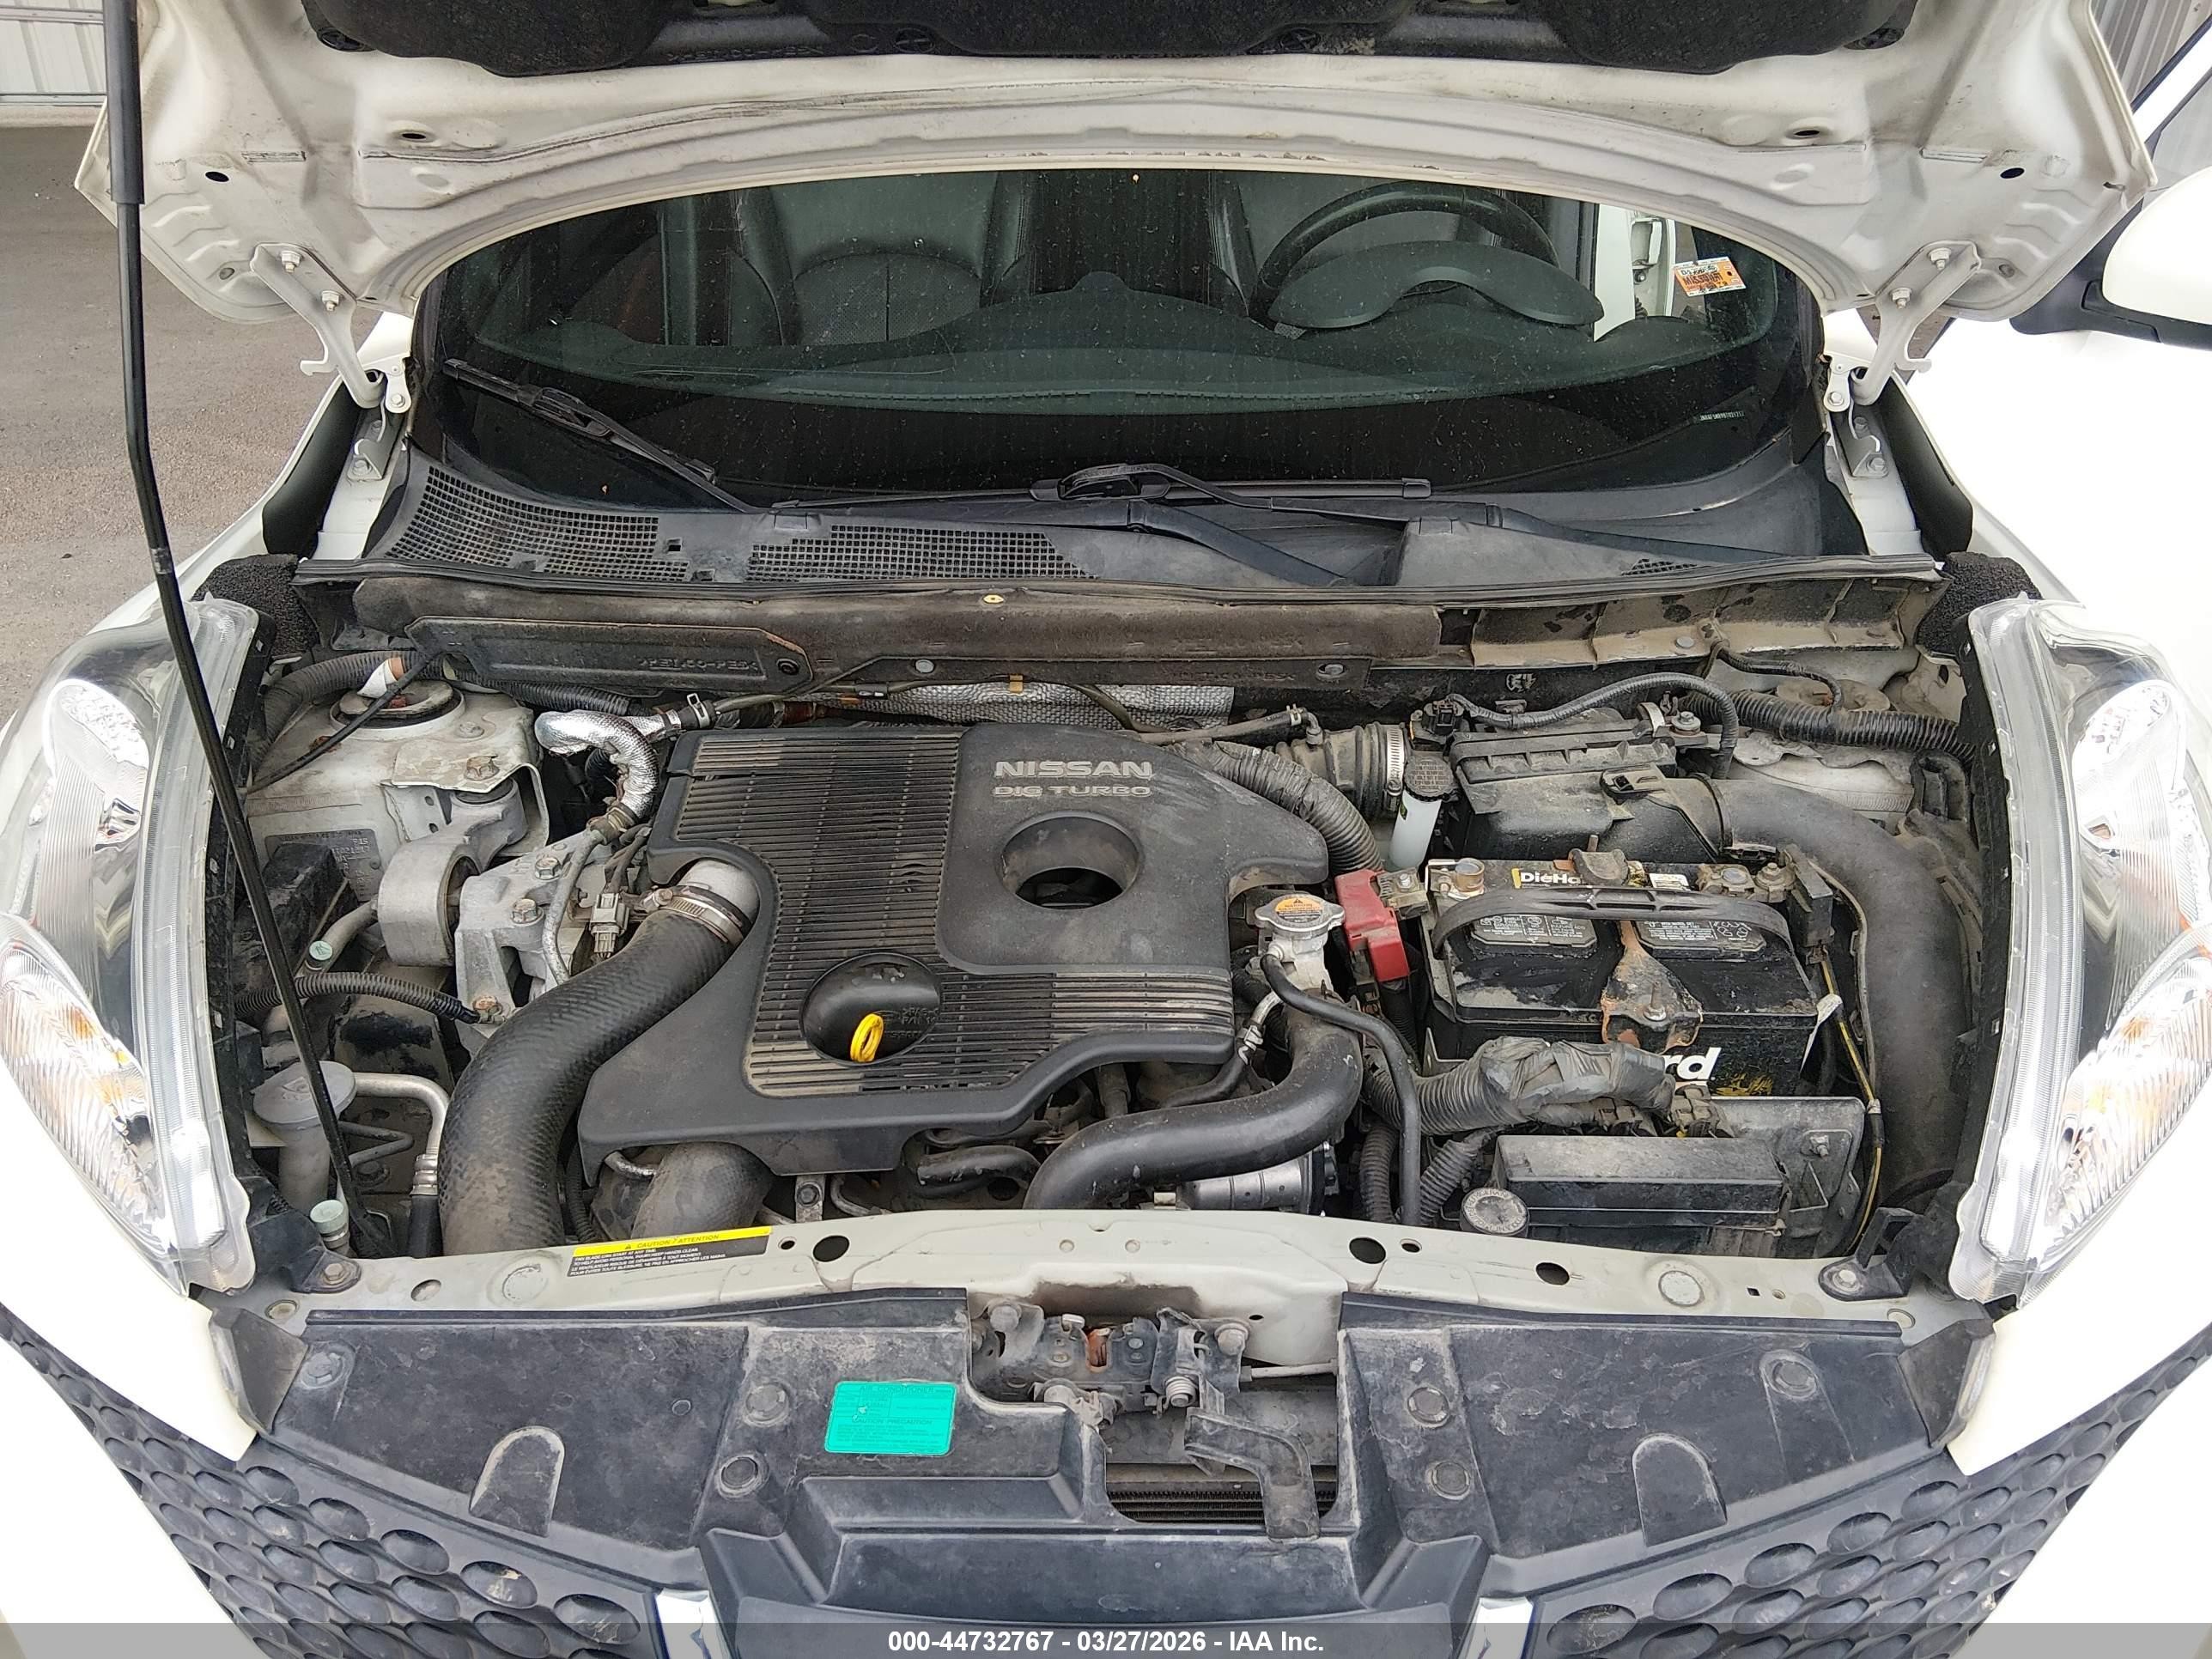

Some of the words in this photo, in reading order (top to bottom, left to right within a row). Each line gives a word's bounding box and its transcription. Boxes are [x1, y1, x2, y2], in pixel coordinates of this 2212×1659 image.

[994, 761, 1152, 779] NISSAN
[993, 786, 1043, 797] DIG
[1048, 786, 1152, 798] TURBO
[1521, 872, 1581, 885] DieHa
[637, 1240, 671, 1249] CAUTION
[677, 1234, 720, 1243] ATTENTION
